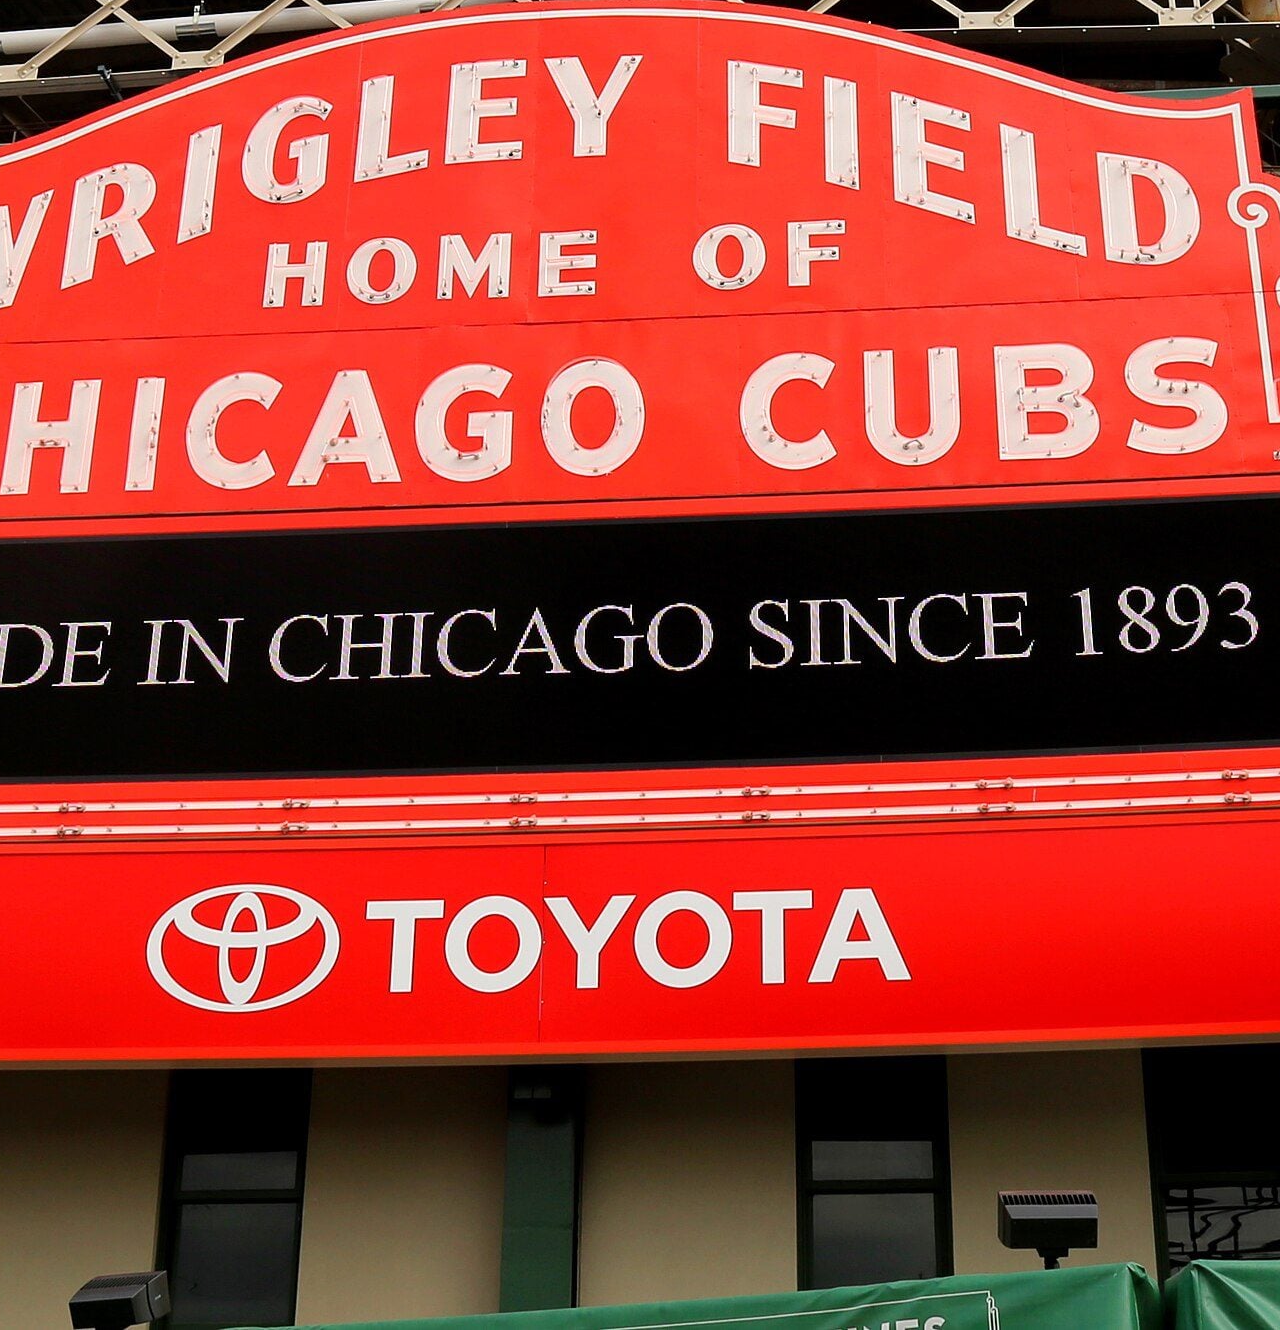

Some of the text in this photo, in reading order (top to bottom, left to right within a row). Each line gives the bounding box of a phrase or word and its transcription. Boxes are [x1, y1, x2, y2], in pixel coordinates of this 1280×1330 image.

[727, 59, 1201, 265] FIELD
[262, 219, 846, 308] HOME OF
[739, 336, 1228, 470] CUBS
[137, 617, 245, 685] IN
[268, 602, 714, 682] CHICAGO
[749, 591, 1035, 670] SINCE
[1072, 581, 1259, 656] 1893
[365, 888, 912, 993] TOYOTA
